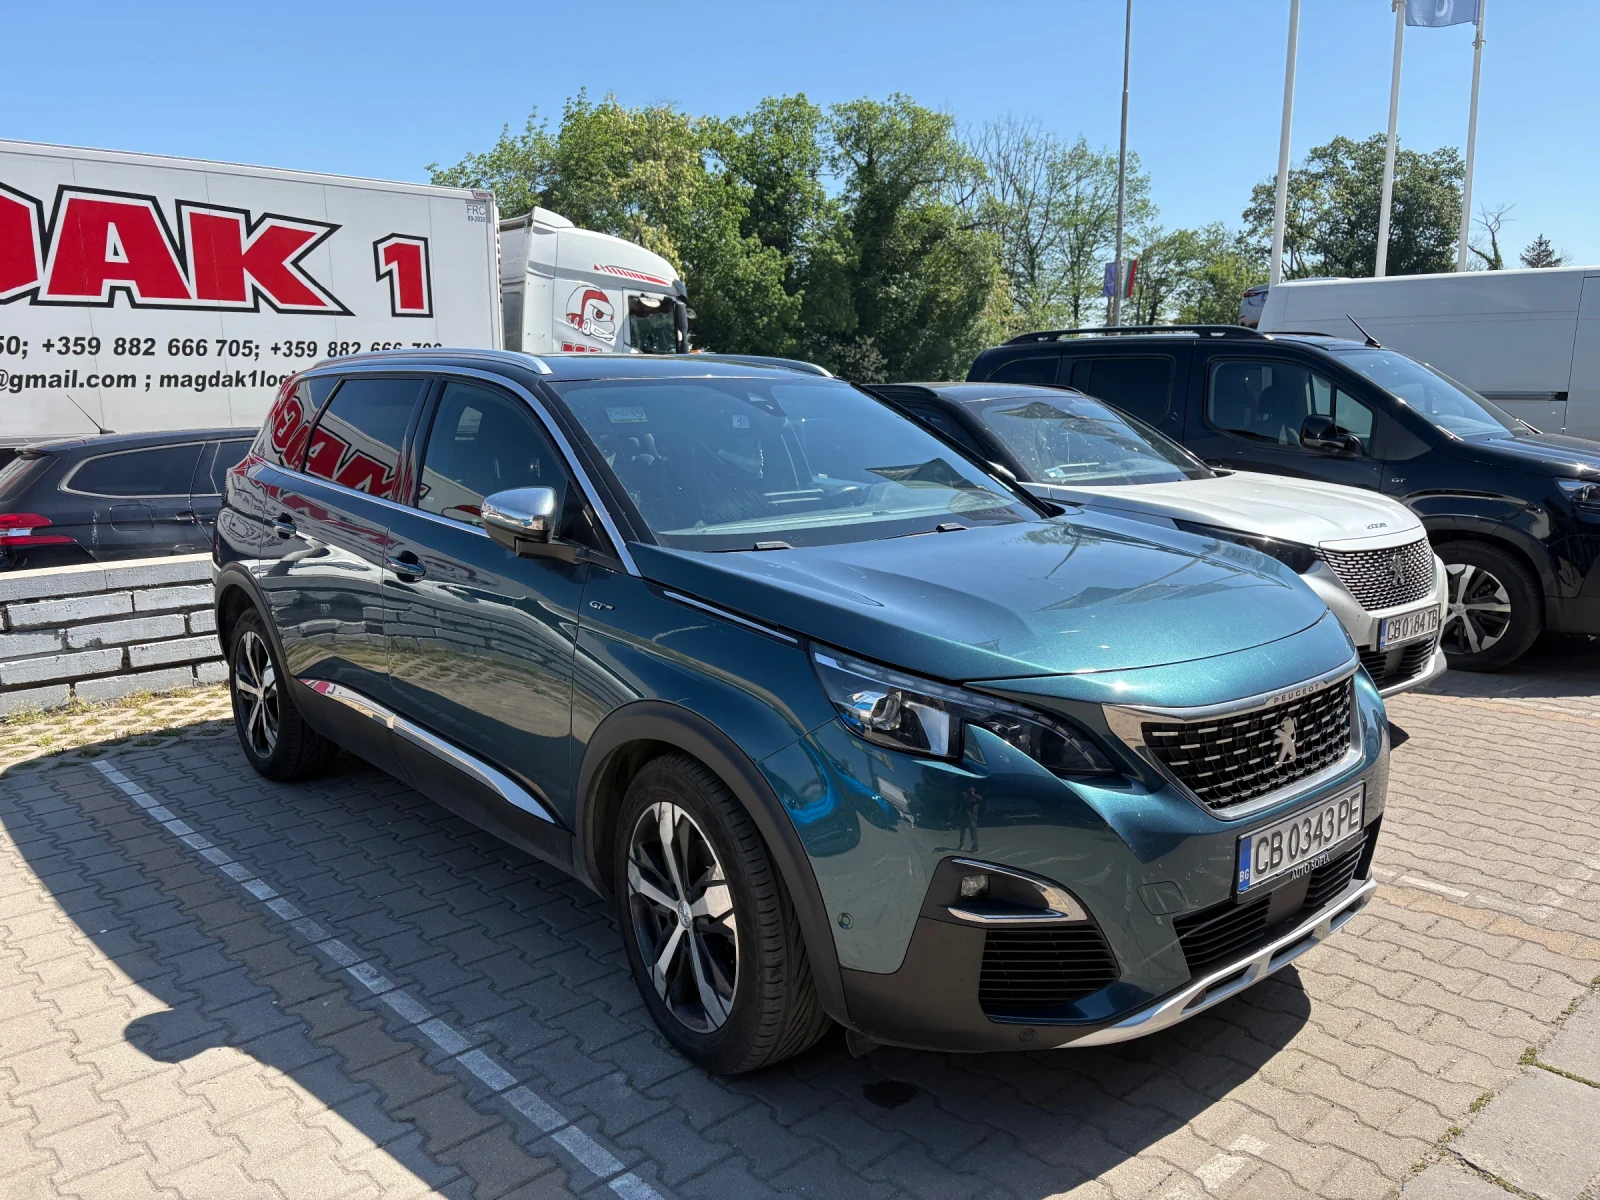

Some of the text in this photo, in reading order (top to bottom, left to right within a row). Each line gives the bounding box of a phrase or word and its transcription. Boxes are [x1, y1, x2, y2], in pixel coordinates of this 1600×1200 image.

[466, 204, 486, 216] FRC
[372, 232, 433, 318] 1
[42, 336, 101, 356] +359
[113, 337, 156, 356] 882
[167, 338, 208, 357] 666
[215, 339, 260, 361] 705;
[270, 340, 318, 358] +359
[327, 341, 361, 358] 882
[159, 370, 296, 393] magdak1lo
[1273, 683, 1320, 704] PEUGEOT
[1239, 868, 1250, 882] BG
[1291, 852, 1331, 881] AUTO SOFIA
